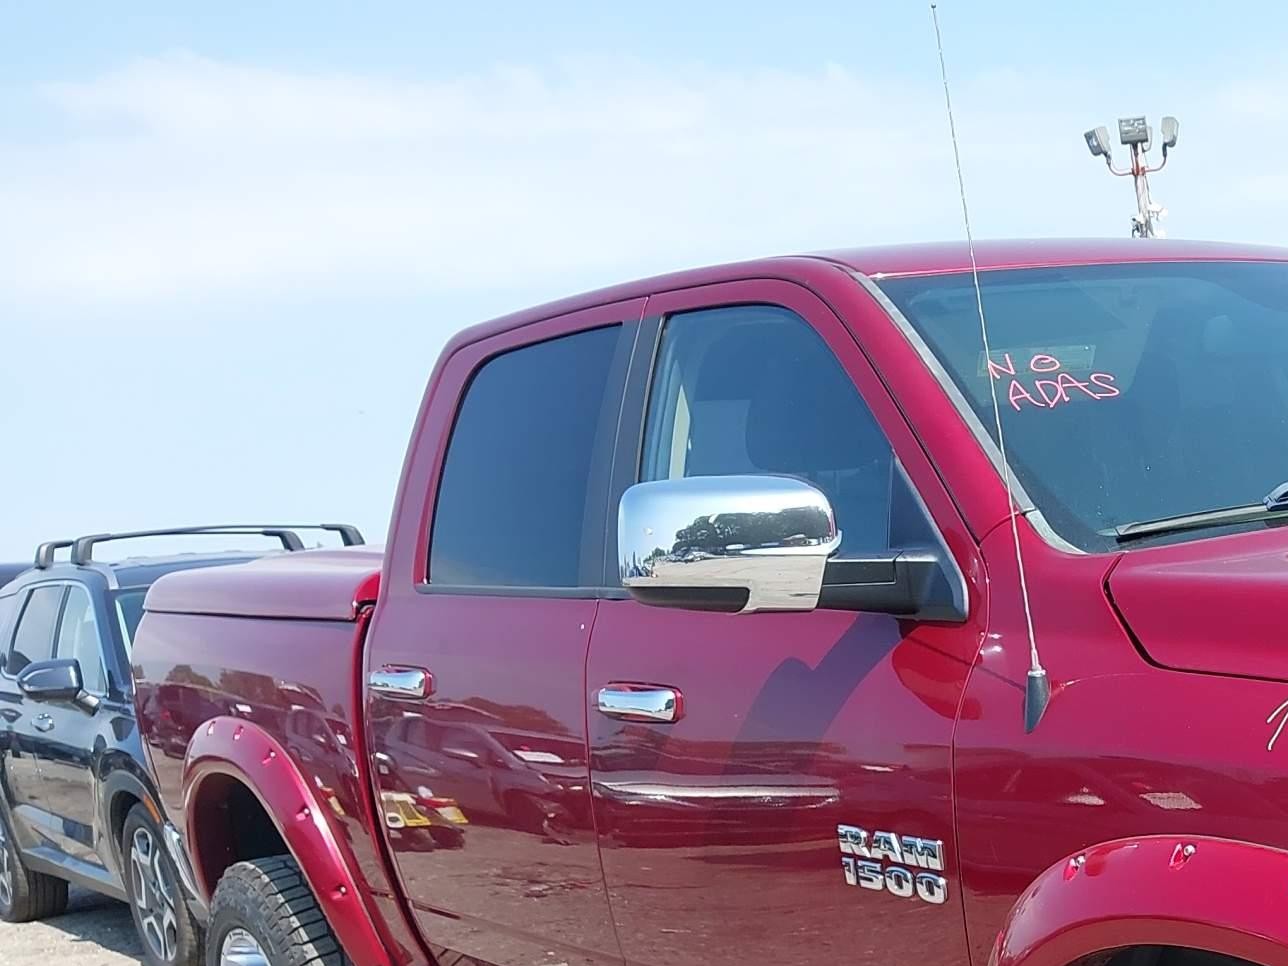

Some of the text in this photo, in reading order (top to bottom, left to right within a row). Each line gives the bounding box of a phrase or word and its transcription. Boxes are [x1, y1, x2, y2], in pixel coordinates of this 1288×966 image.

[988, 353, 1061, 380] NO
[1008, 373, 1120, 412] ADAS
[837, 824, 945, 871] RAM
[841, 856, 948, 905] 1500
